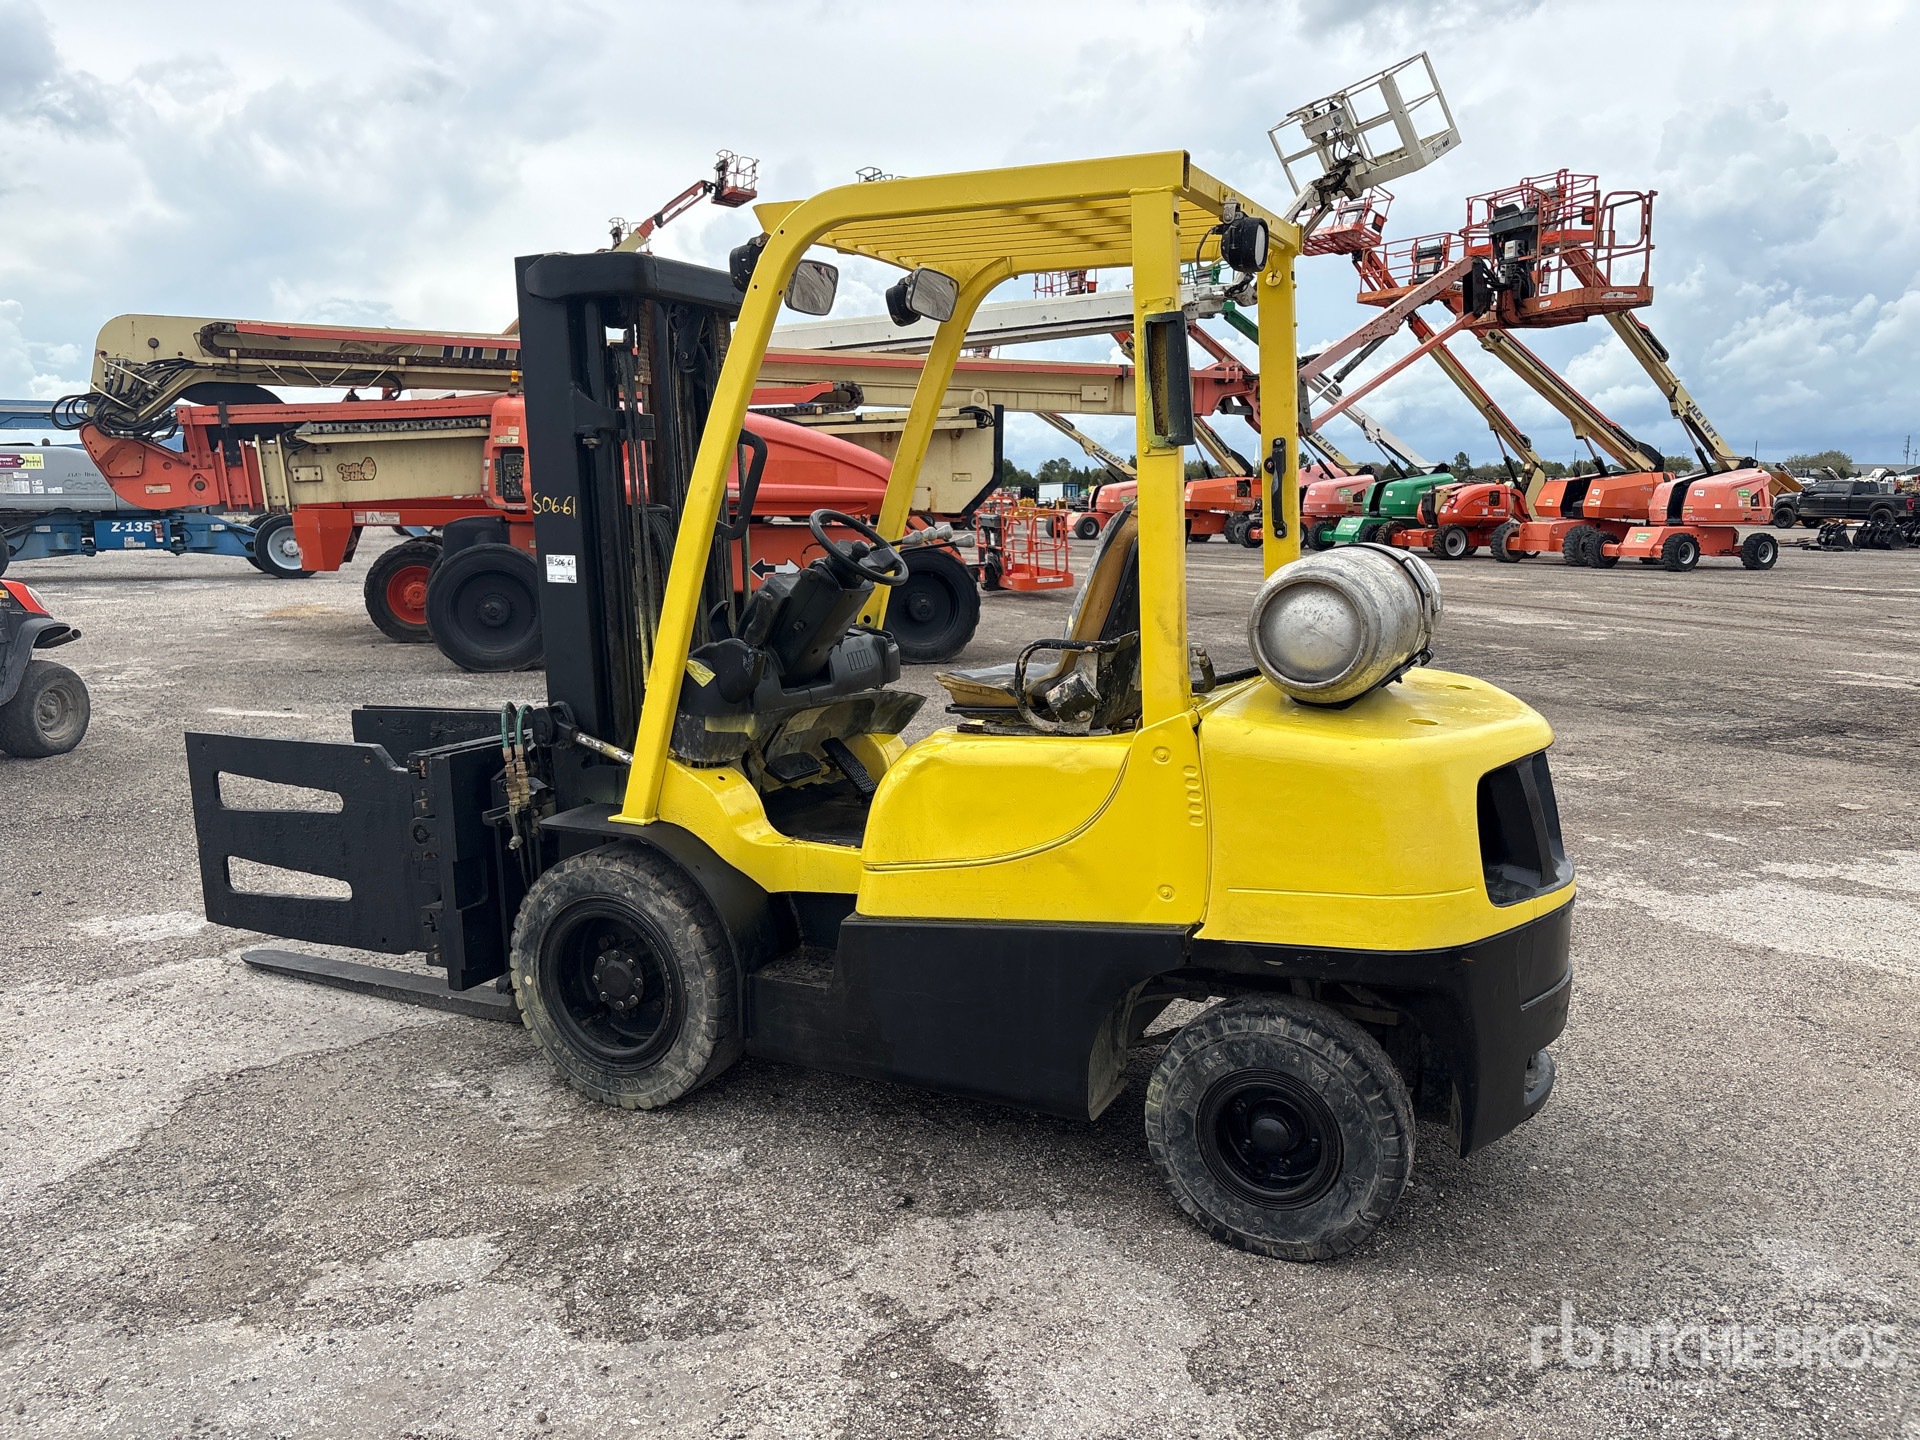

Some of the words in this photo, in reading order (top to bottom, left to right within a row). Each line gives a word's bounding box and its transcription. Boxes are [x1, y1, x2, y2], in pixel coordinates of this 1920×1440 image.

[1686, 404, 1703, 421] JLG
[1700, 419, 1718, 439] LIFT
[111, 521, 153, 533] Z-135
